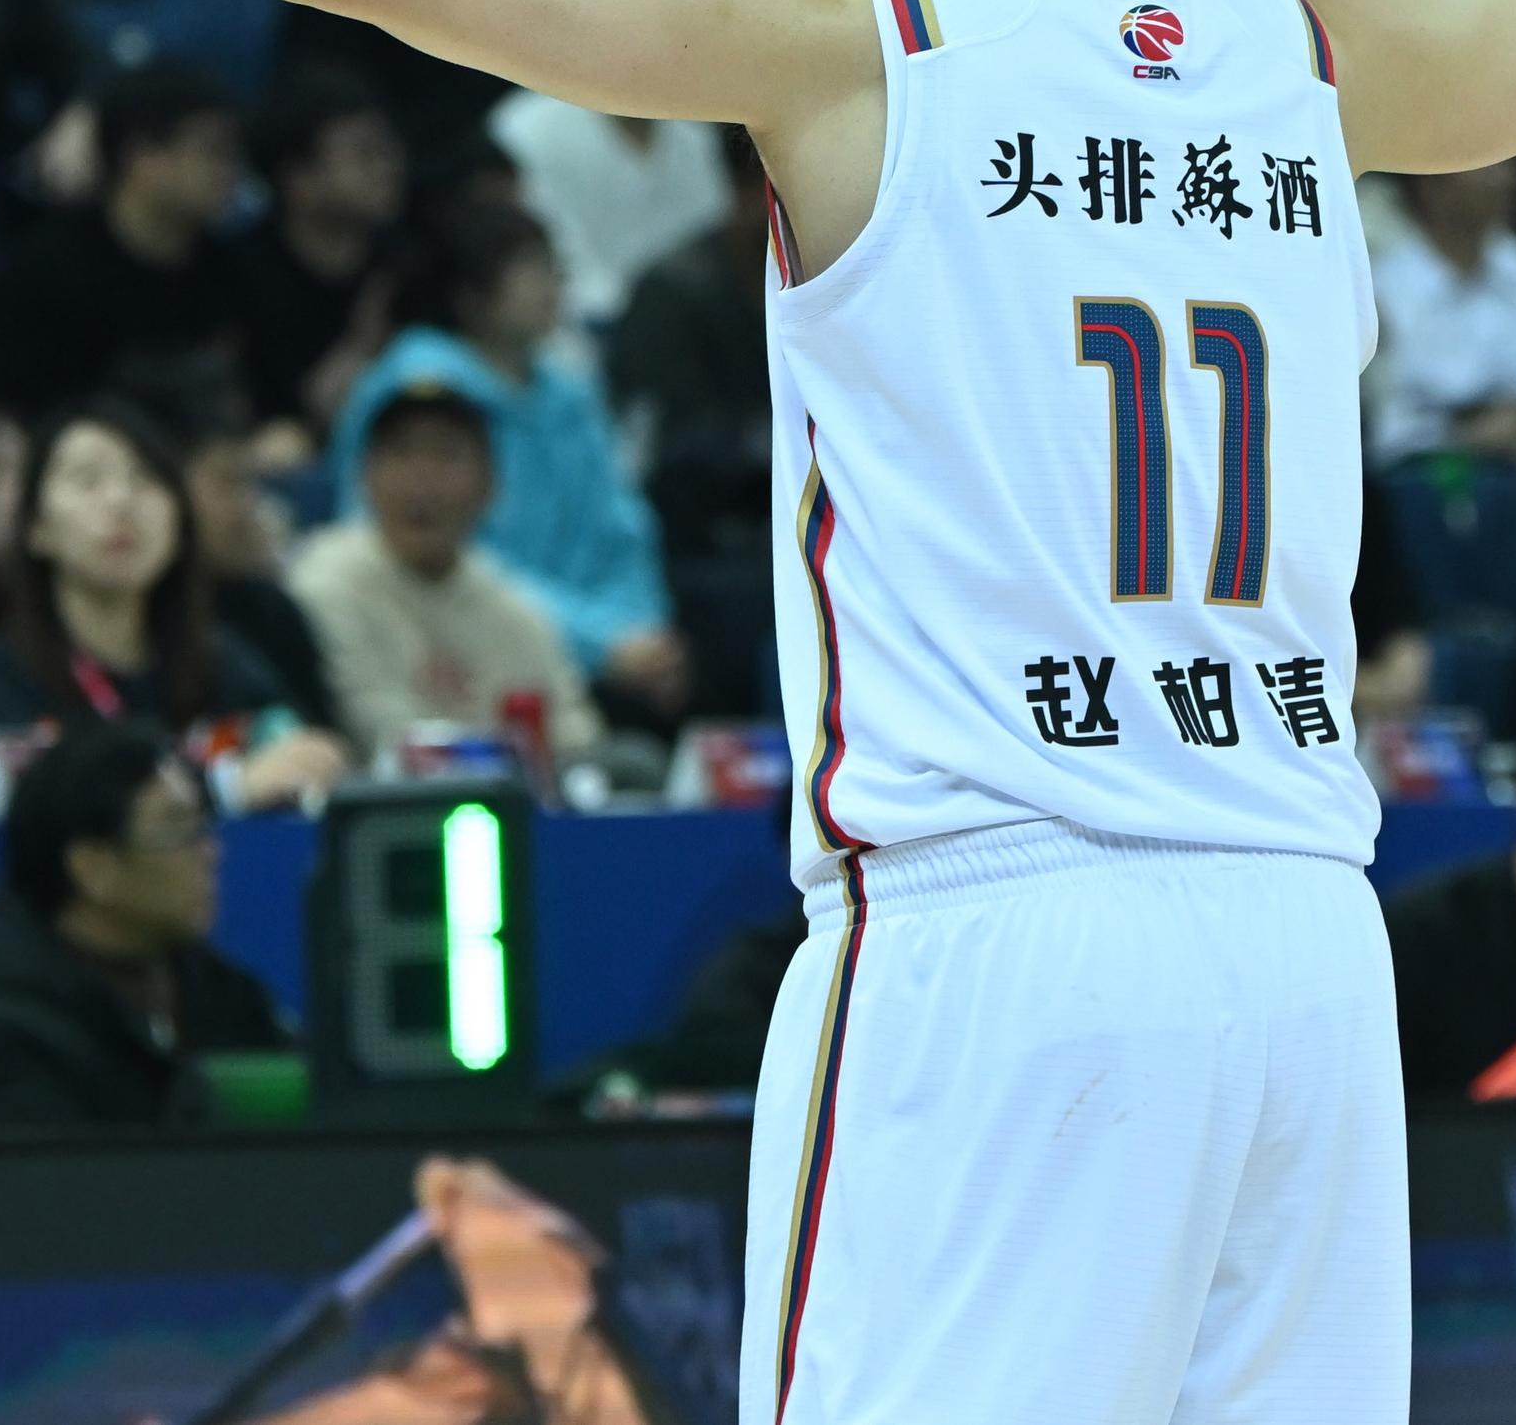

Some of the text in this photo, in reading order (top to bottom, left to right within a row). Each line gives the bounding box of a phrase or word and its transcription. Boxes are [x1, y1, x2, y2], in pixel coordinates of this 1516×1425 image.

[1132, 64, 1181, 81] CBA
[1072, 295, 1272, 609] 11
[1023, 654, 1341, 749] 赵柏清
